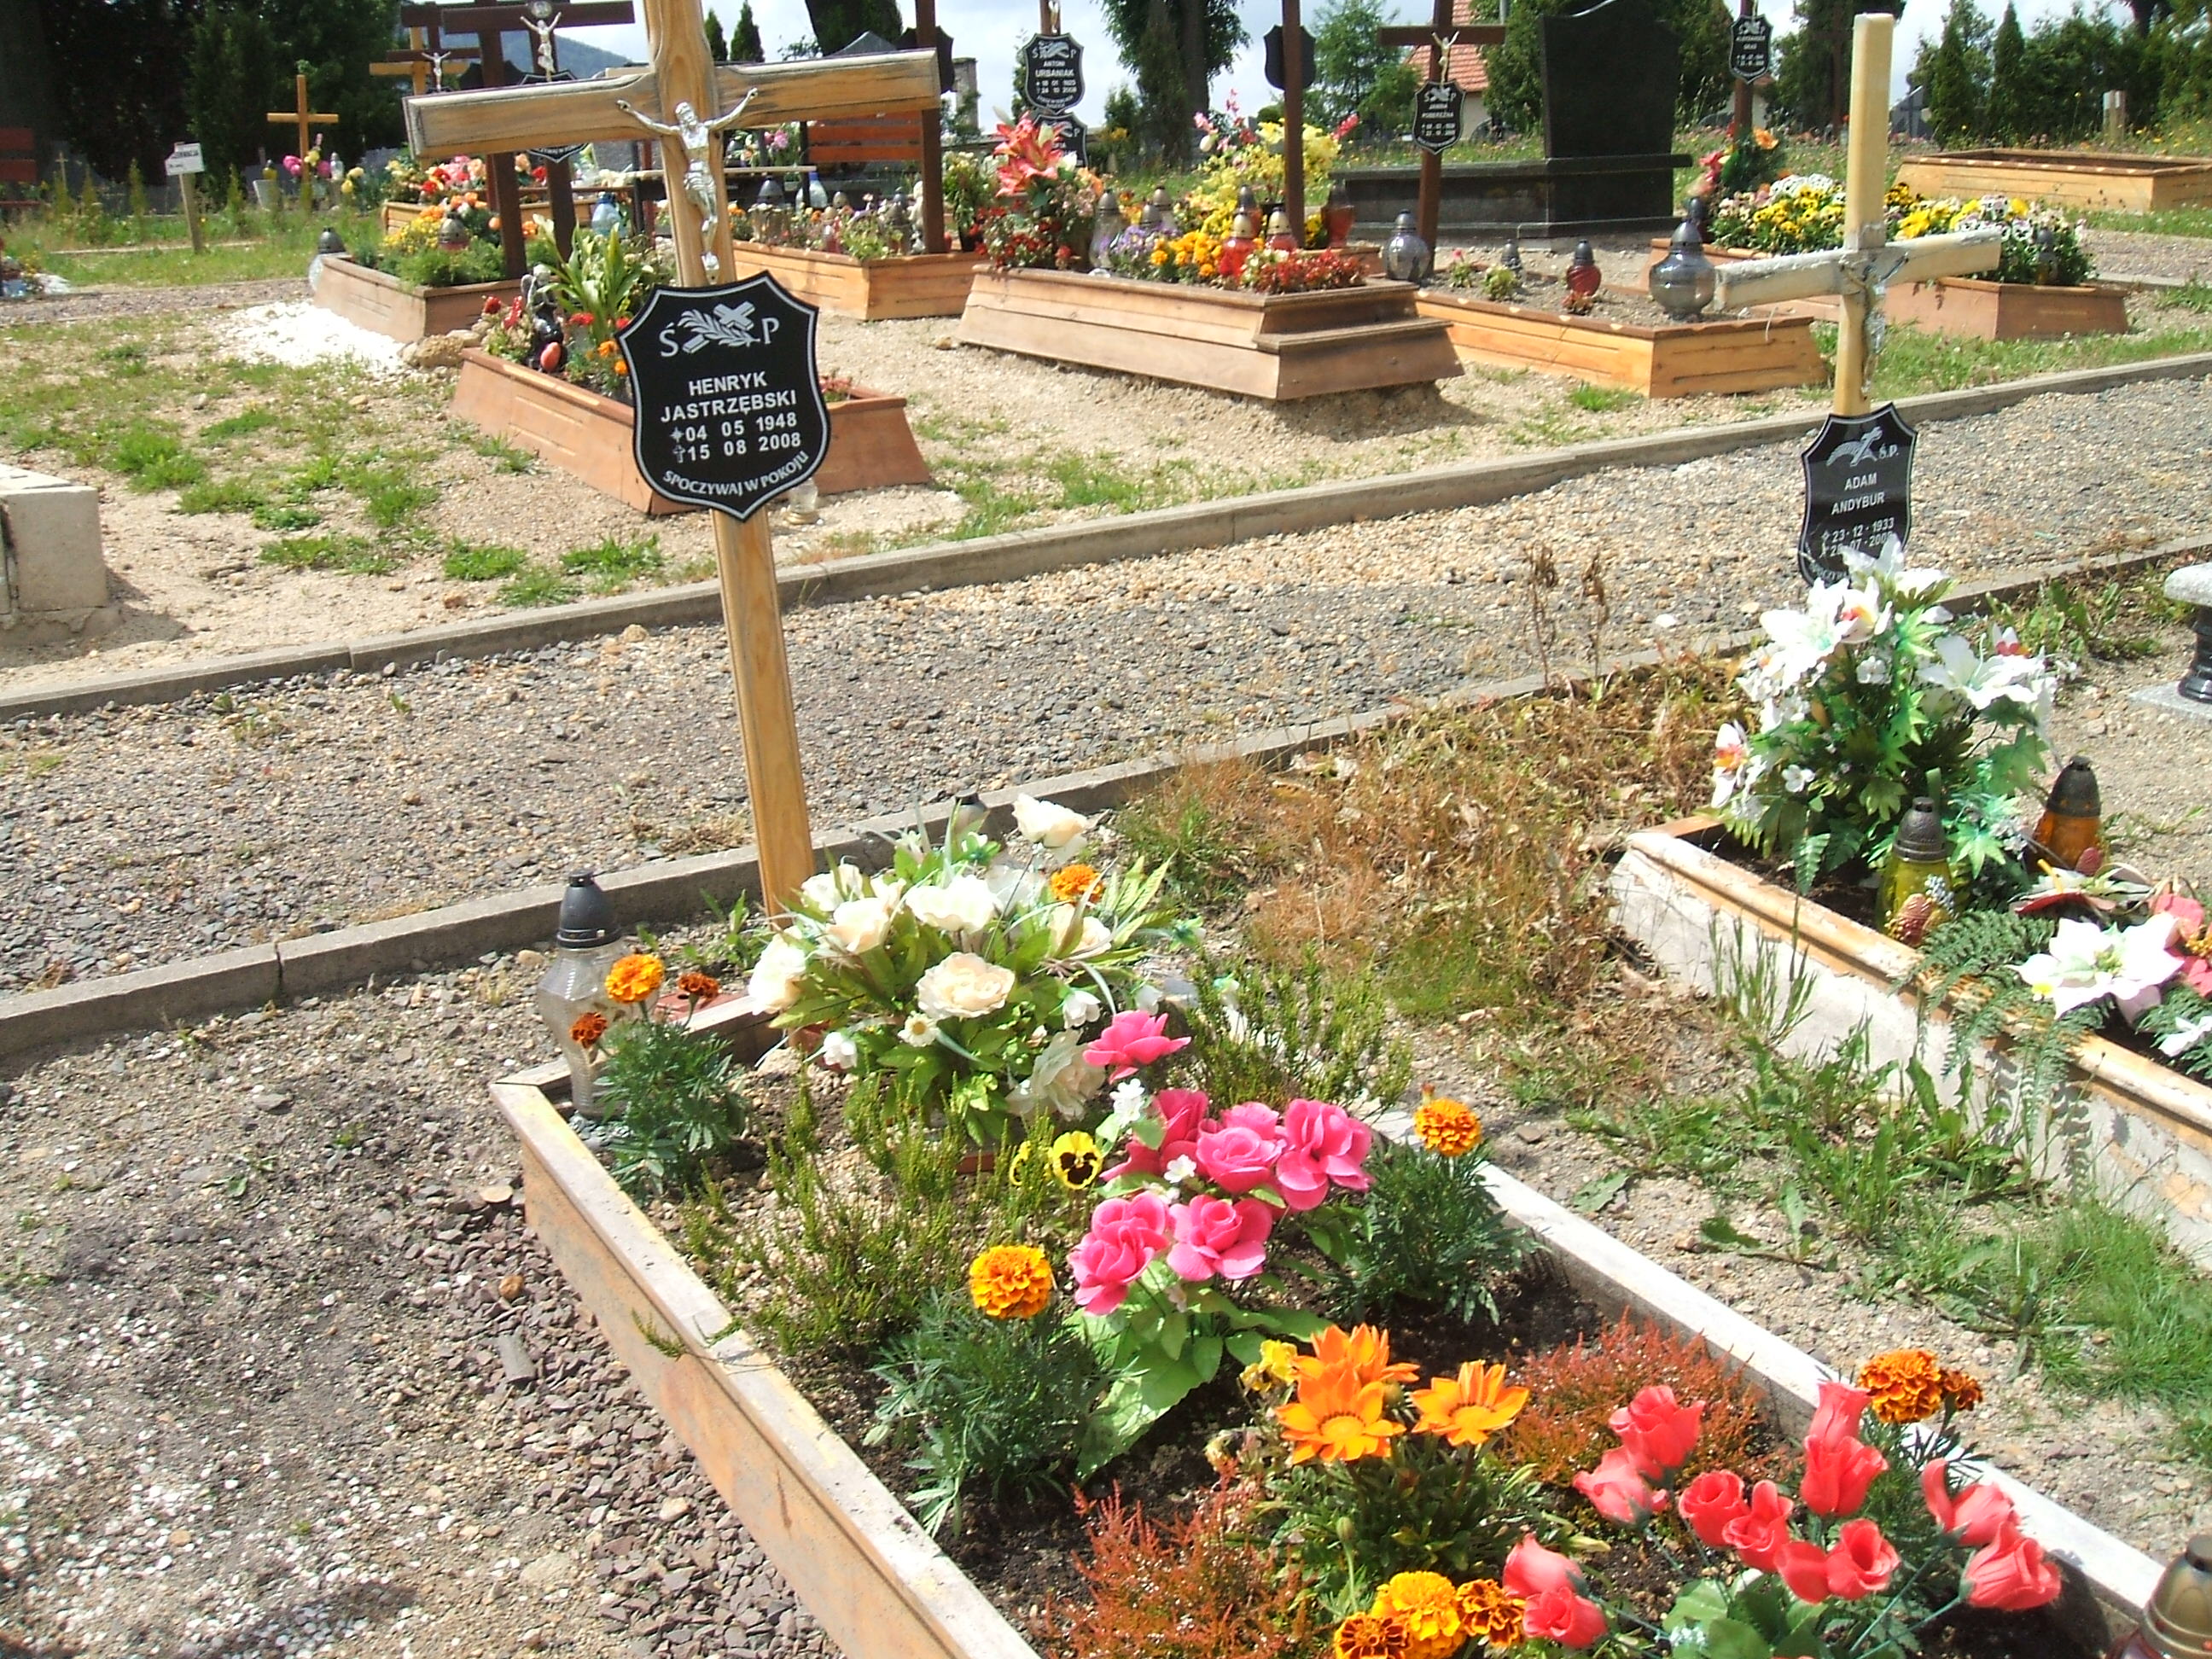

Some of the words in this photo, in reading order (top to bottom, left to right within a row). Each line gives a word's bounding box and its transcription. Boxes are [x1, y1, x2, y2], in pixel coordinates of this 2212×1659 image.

[1034, 69, 1075, 78] URBANIAK
[658, 322, 679, 358] Ś
[761, 317, 780, 345] P
[688, 371, 768, 396] HENRYK
[660, 389, 798, 423] JASTRZĘBSKI
[684, 425, 708, 442] 04
[721, 420, 745, 437] 05
[755, 411, 798, 433] 1948
[687, 444, 711, 462] 15
[723, 439, 748, 457] 08
[758, 432, 802, 452] 2008
[662, 470, 743, 497] SPOCZYWAJ
[744, 479, 760, 492] W
[760, 450, 810, 488] POKOJU
[1844, 472, 1877, 492] ADAM
[1831, 492, 1886, 515] ANDYBUR
